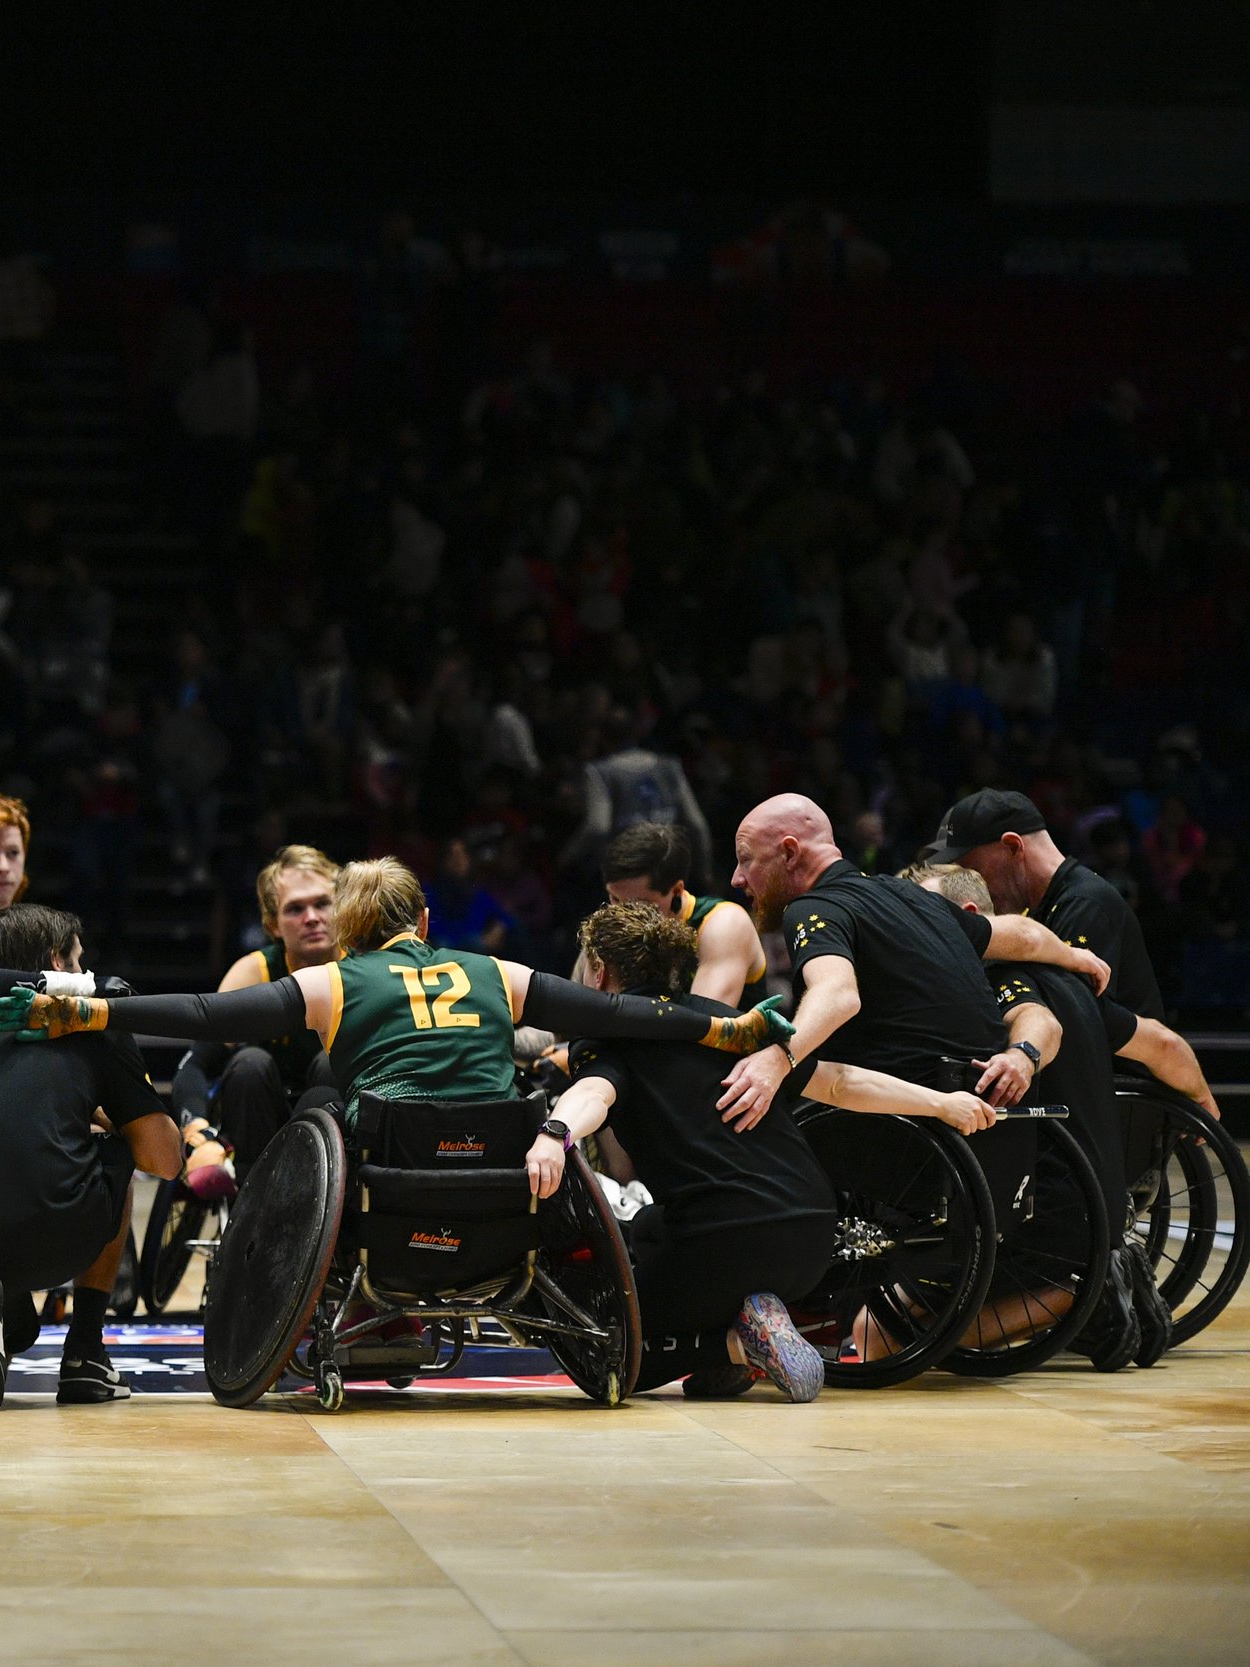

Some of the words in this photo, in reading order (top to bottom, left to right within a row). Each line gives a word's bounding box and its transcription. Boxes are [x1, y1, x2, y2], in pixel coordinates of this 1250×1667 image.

[389, 962, 480, 1029] 12
[438, 1140, 487, 1151] Melrose
[411, 1232, 461, 1247] Melrose
